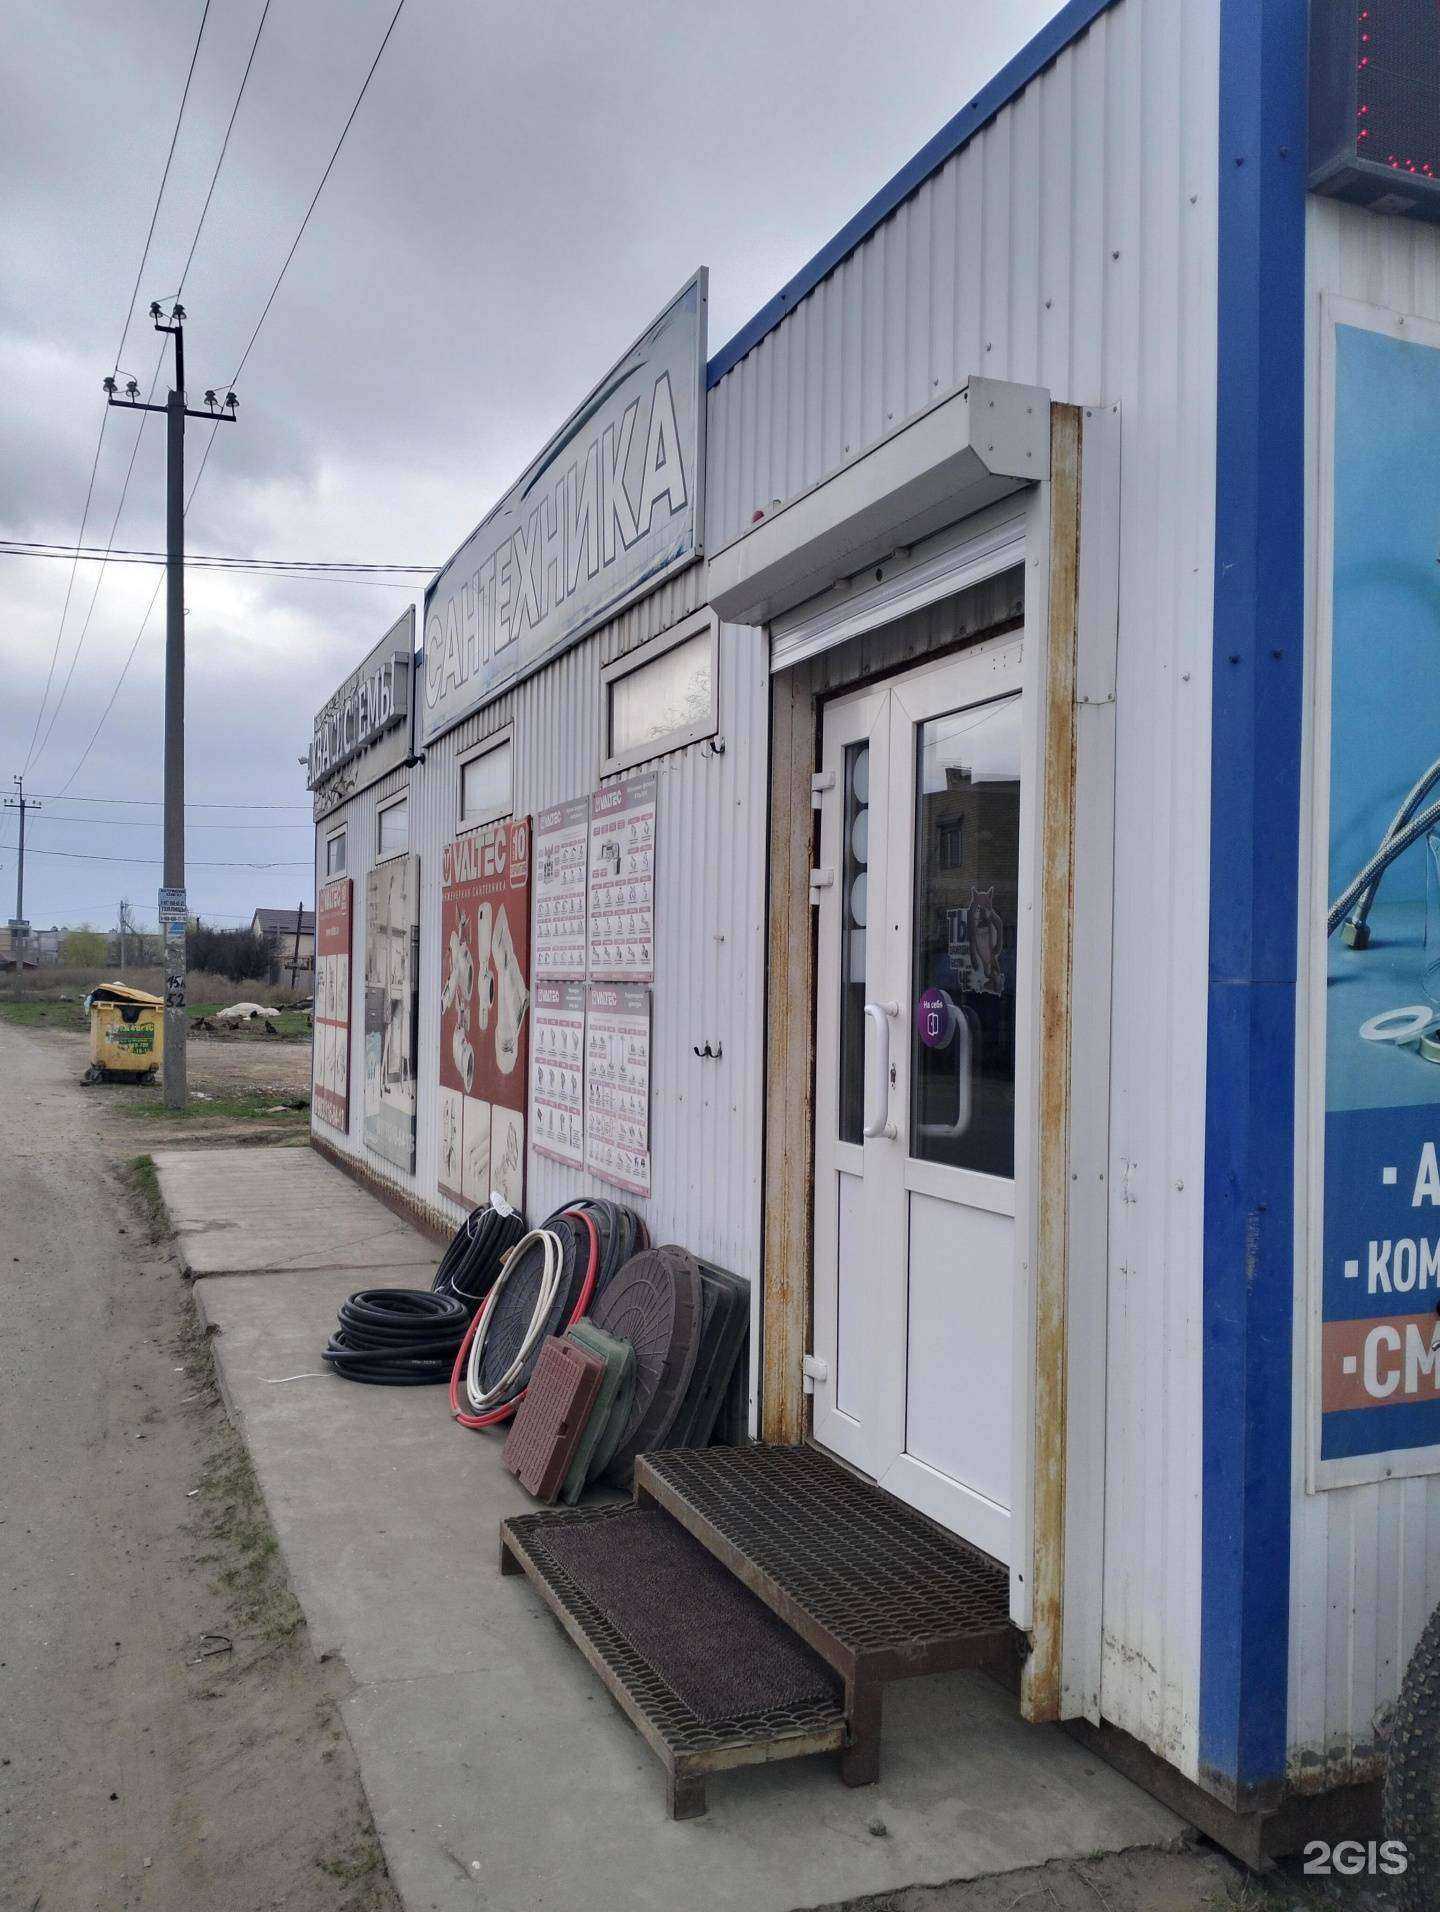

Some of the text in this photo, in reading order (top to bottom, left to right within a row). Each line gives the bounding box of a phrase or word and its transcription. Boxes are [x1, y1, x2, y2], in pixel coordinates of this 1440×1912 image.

[426, 369, 688, 709] САНТЕХНИКА
[452, 828, 506, 883] VALTEC
[596, 991, 618, 1006] VALTEC
[1368, 1236, 1440, 1294] КОМ
[1364, 1322, 1440, 1398] СМ
